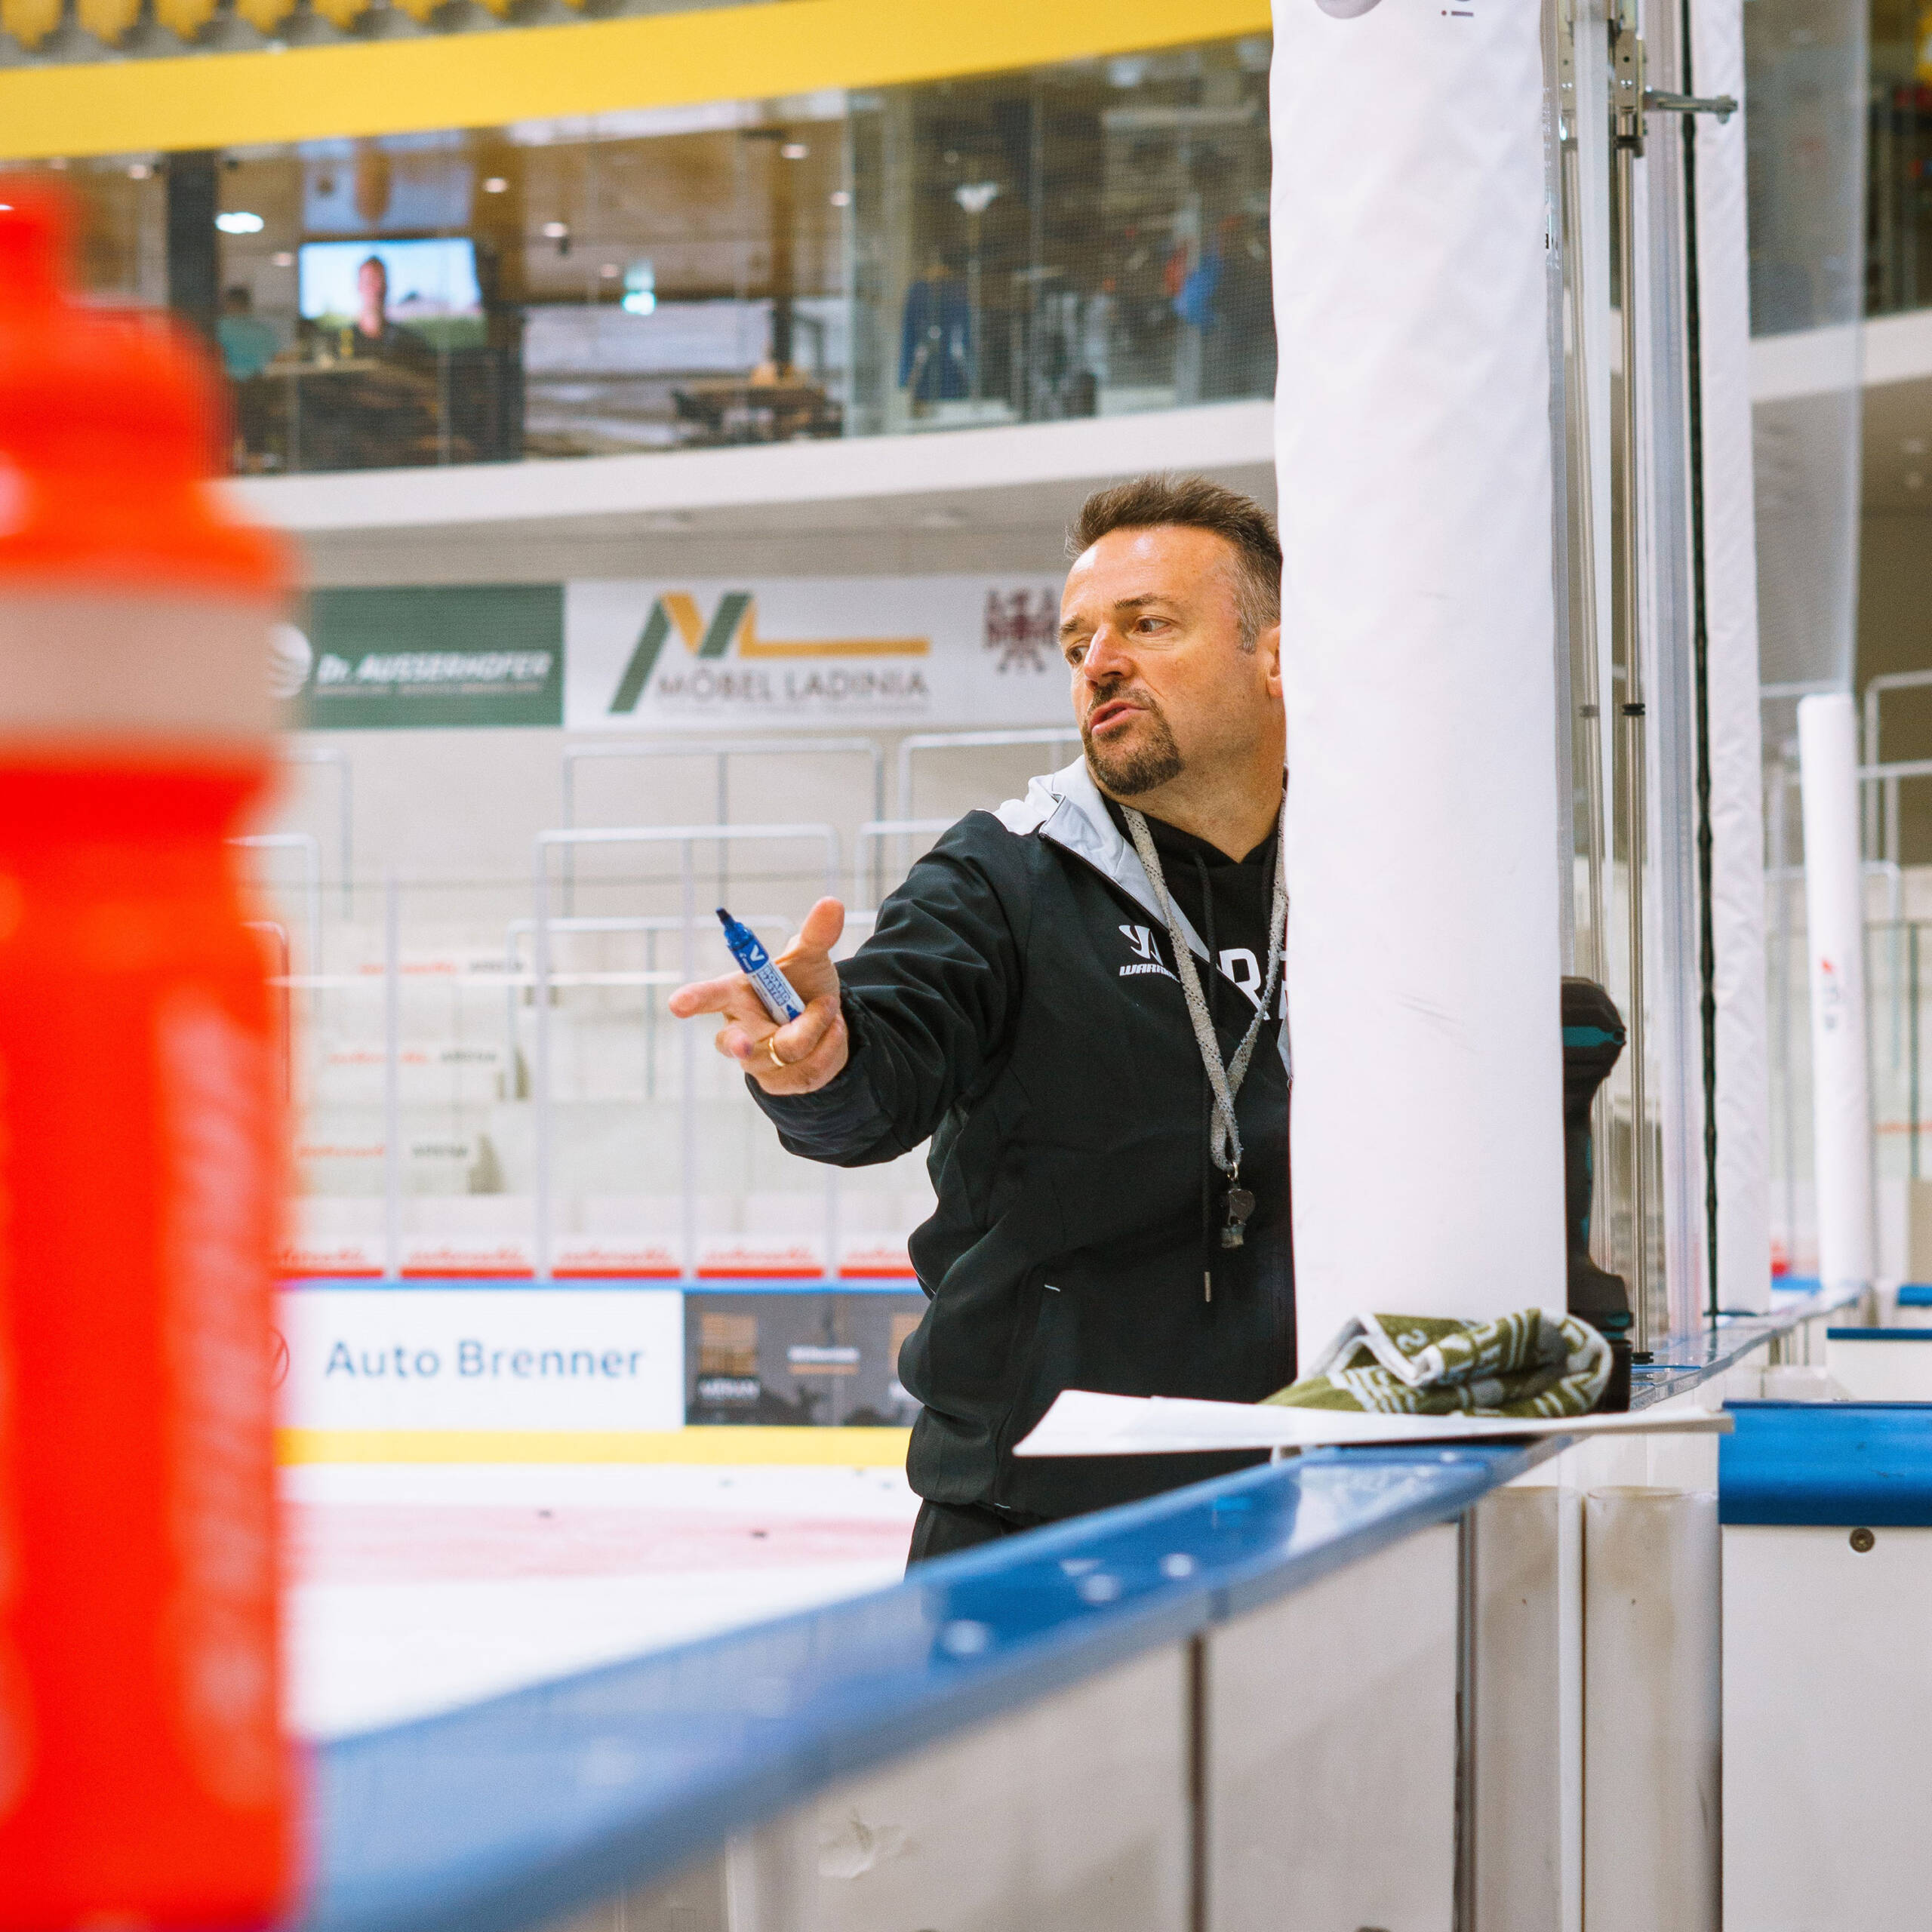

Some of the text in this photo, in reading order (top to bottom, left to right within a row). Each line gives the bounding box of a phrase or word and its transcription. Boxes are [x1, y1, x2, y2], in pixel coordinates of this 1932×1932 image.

[659, 666, 771, 701] MÖBEL
[758, 969, 786, 1006] MASTER
[762, 965, 791, 1001] BOARD
[326, 1338, 644, 1379] Auto Brenner
